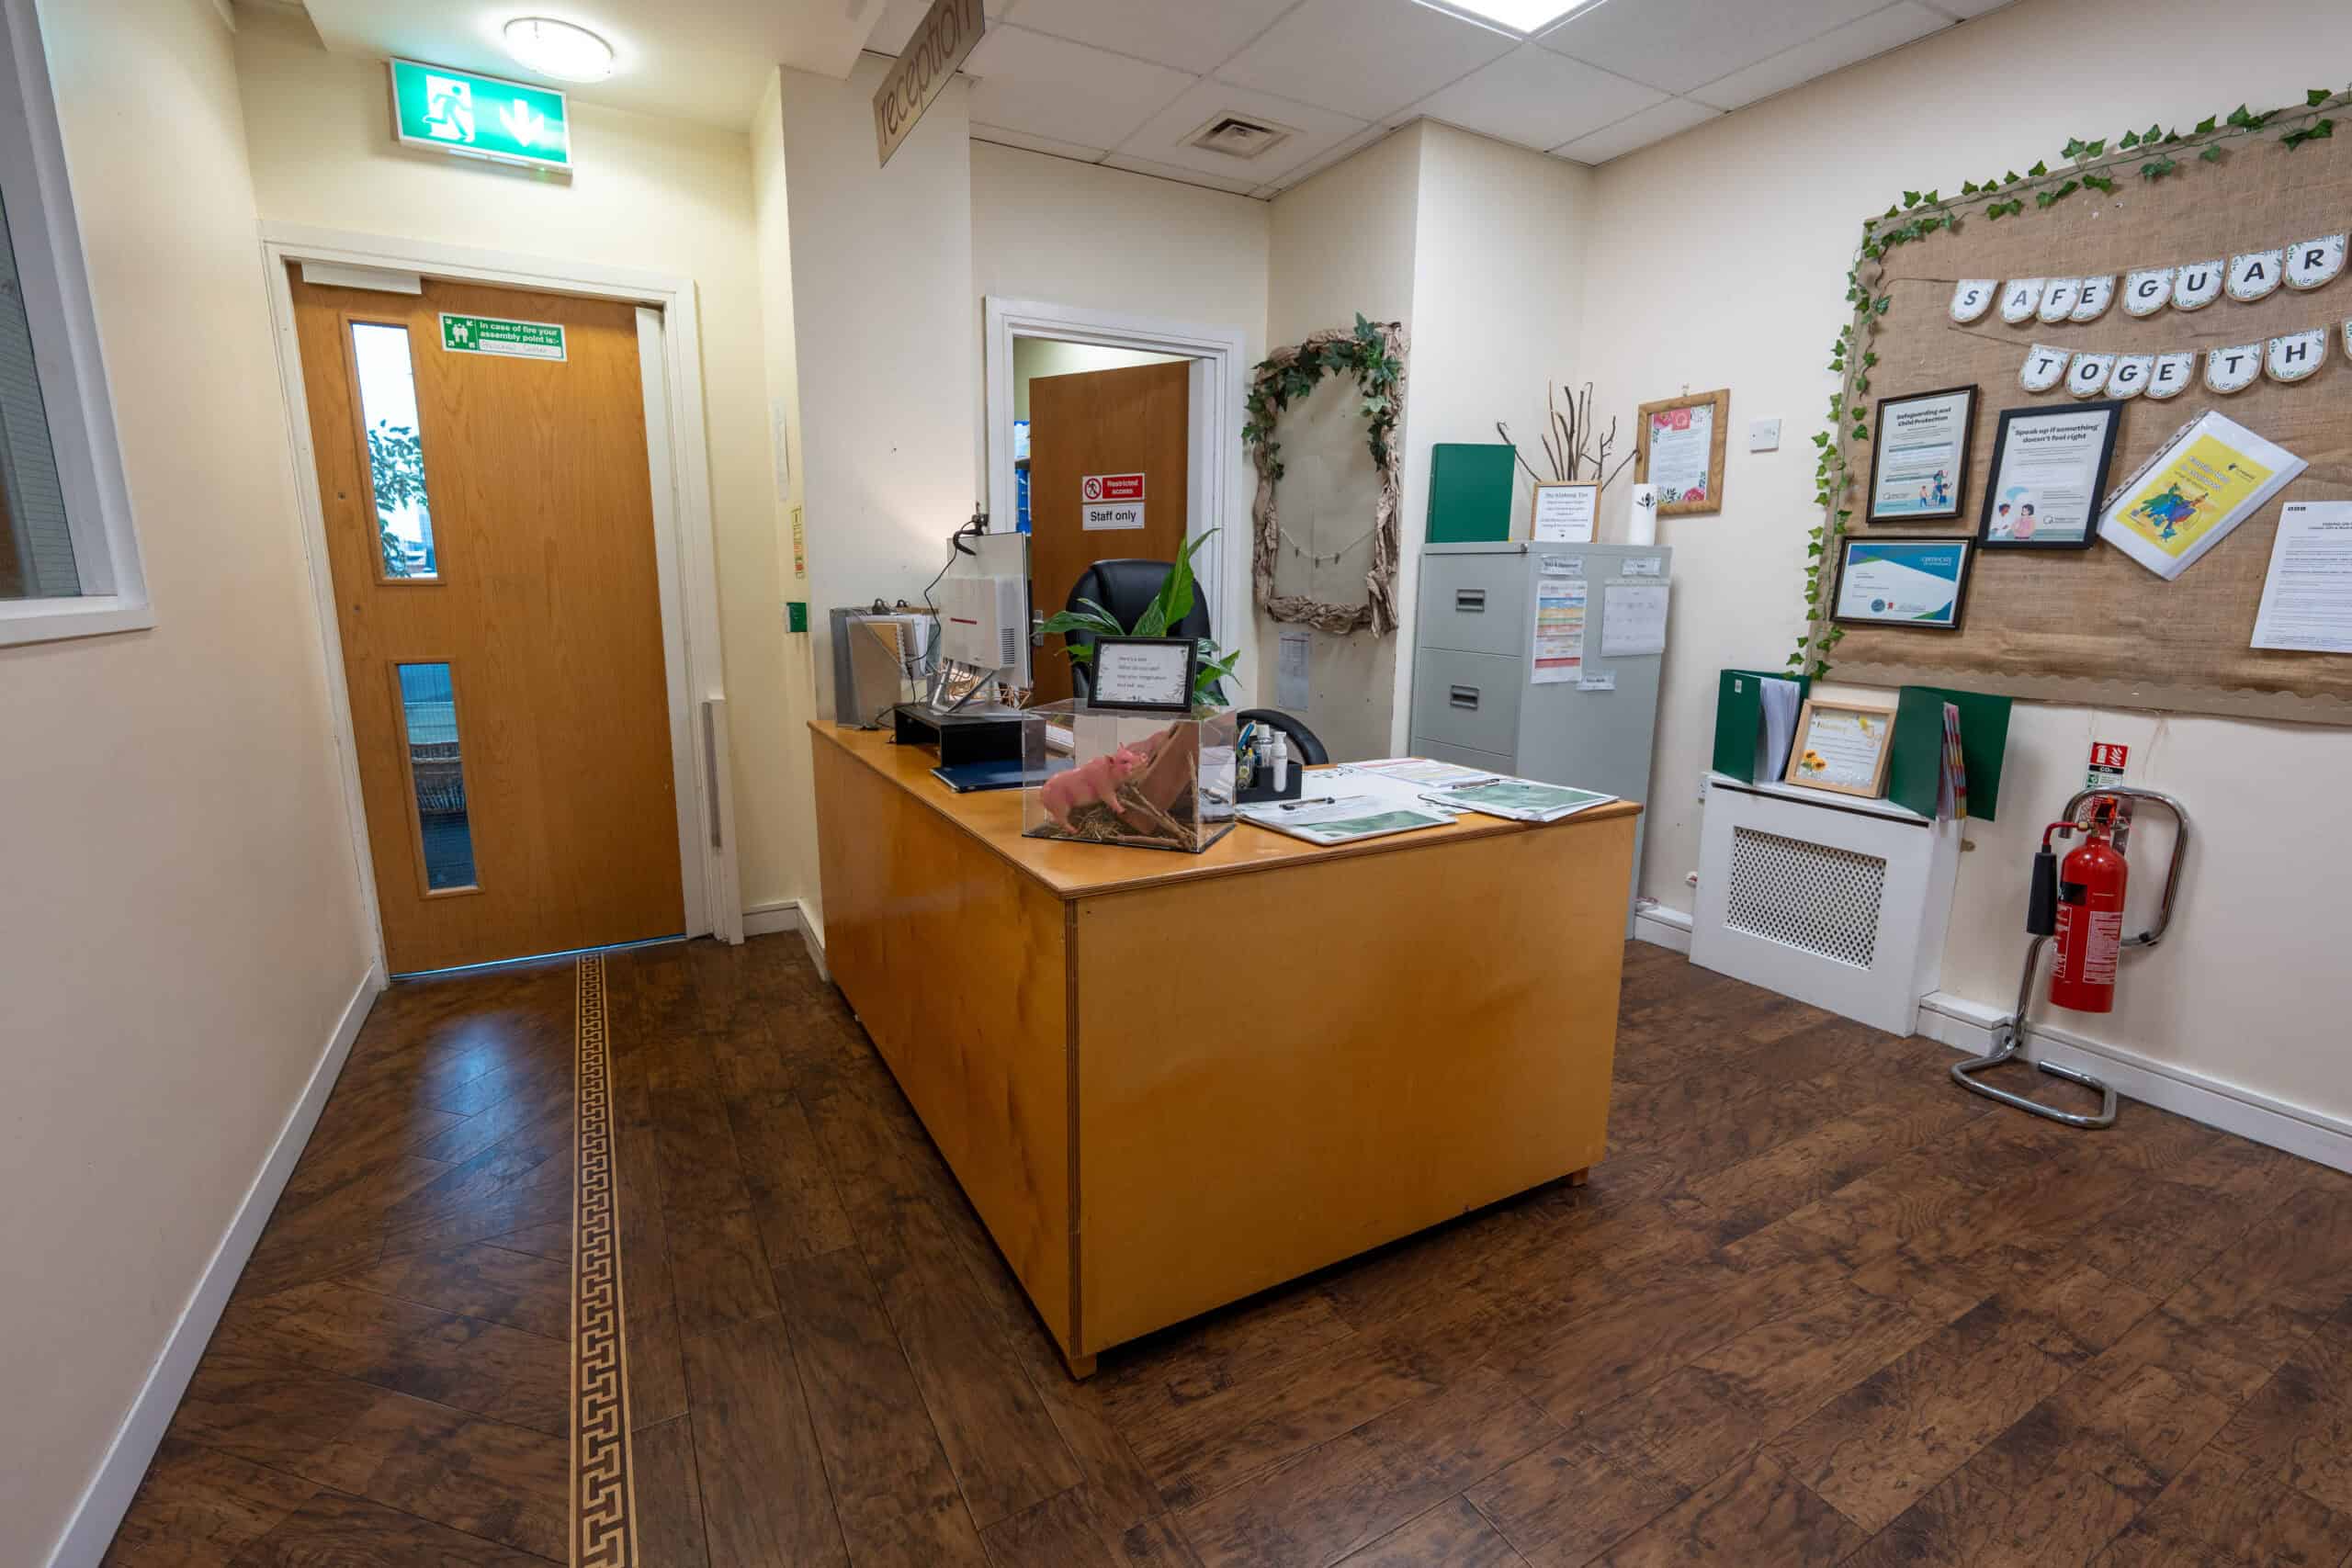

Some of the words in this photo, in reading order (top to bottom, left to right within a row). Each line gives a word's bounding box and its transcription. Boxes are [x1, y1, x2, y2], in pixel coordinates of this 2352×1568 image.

[881, 0, 972, 146] reception
[491, 323, 510, 333] case
[538, 328, 558, 336] your
[480, 331, 520, 342] assembly
[522, 334, 545, 344] point
[1896, 409, 1938, 420] Safeguarding
[1897, 419, 1914, 427] Child
[1915, 415, 1949, 424] Protection
[2067, 433, 2086, 442] right
[1090, 511, 1114, 522] Staff
[1115, 510, 1136, 523] only
